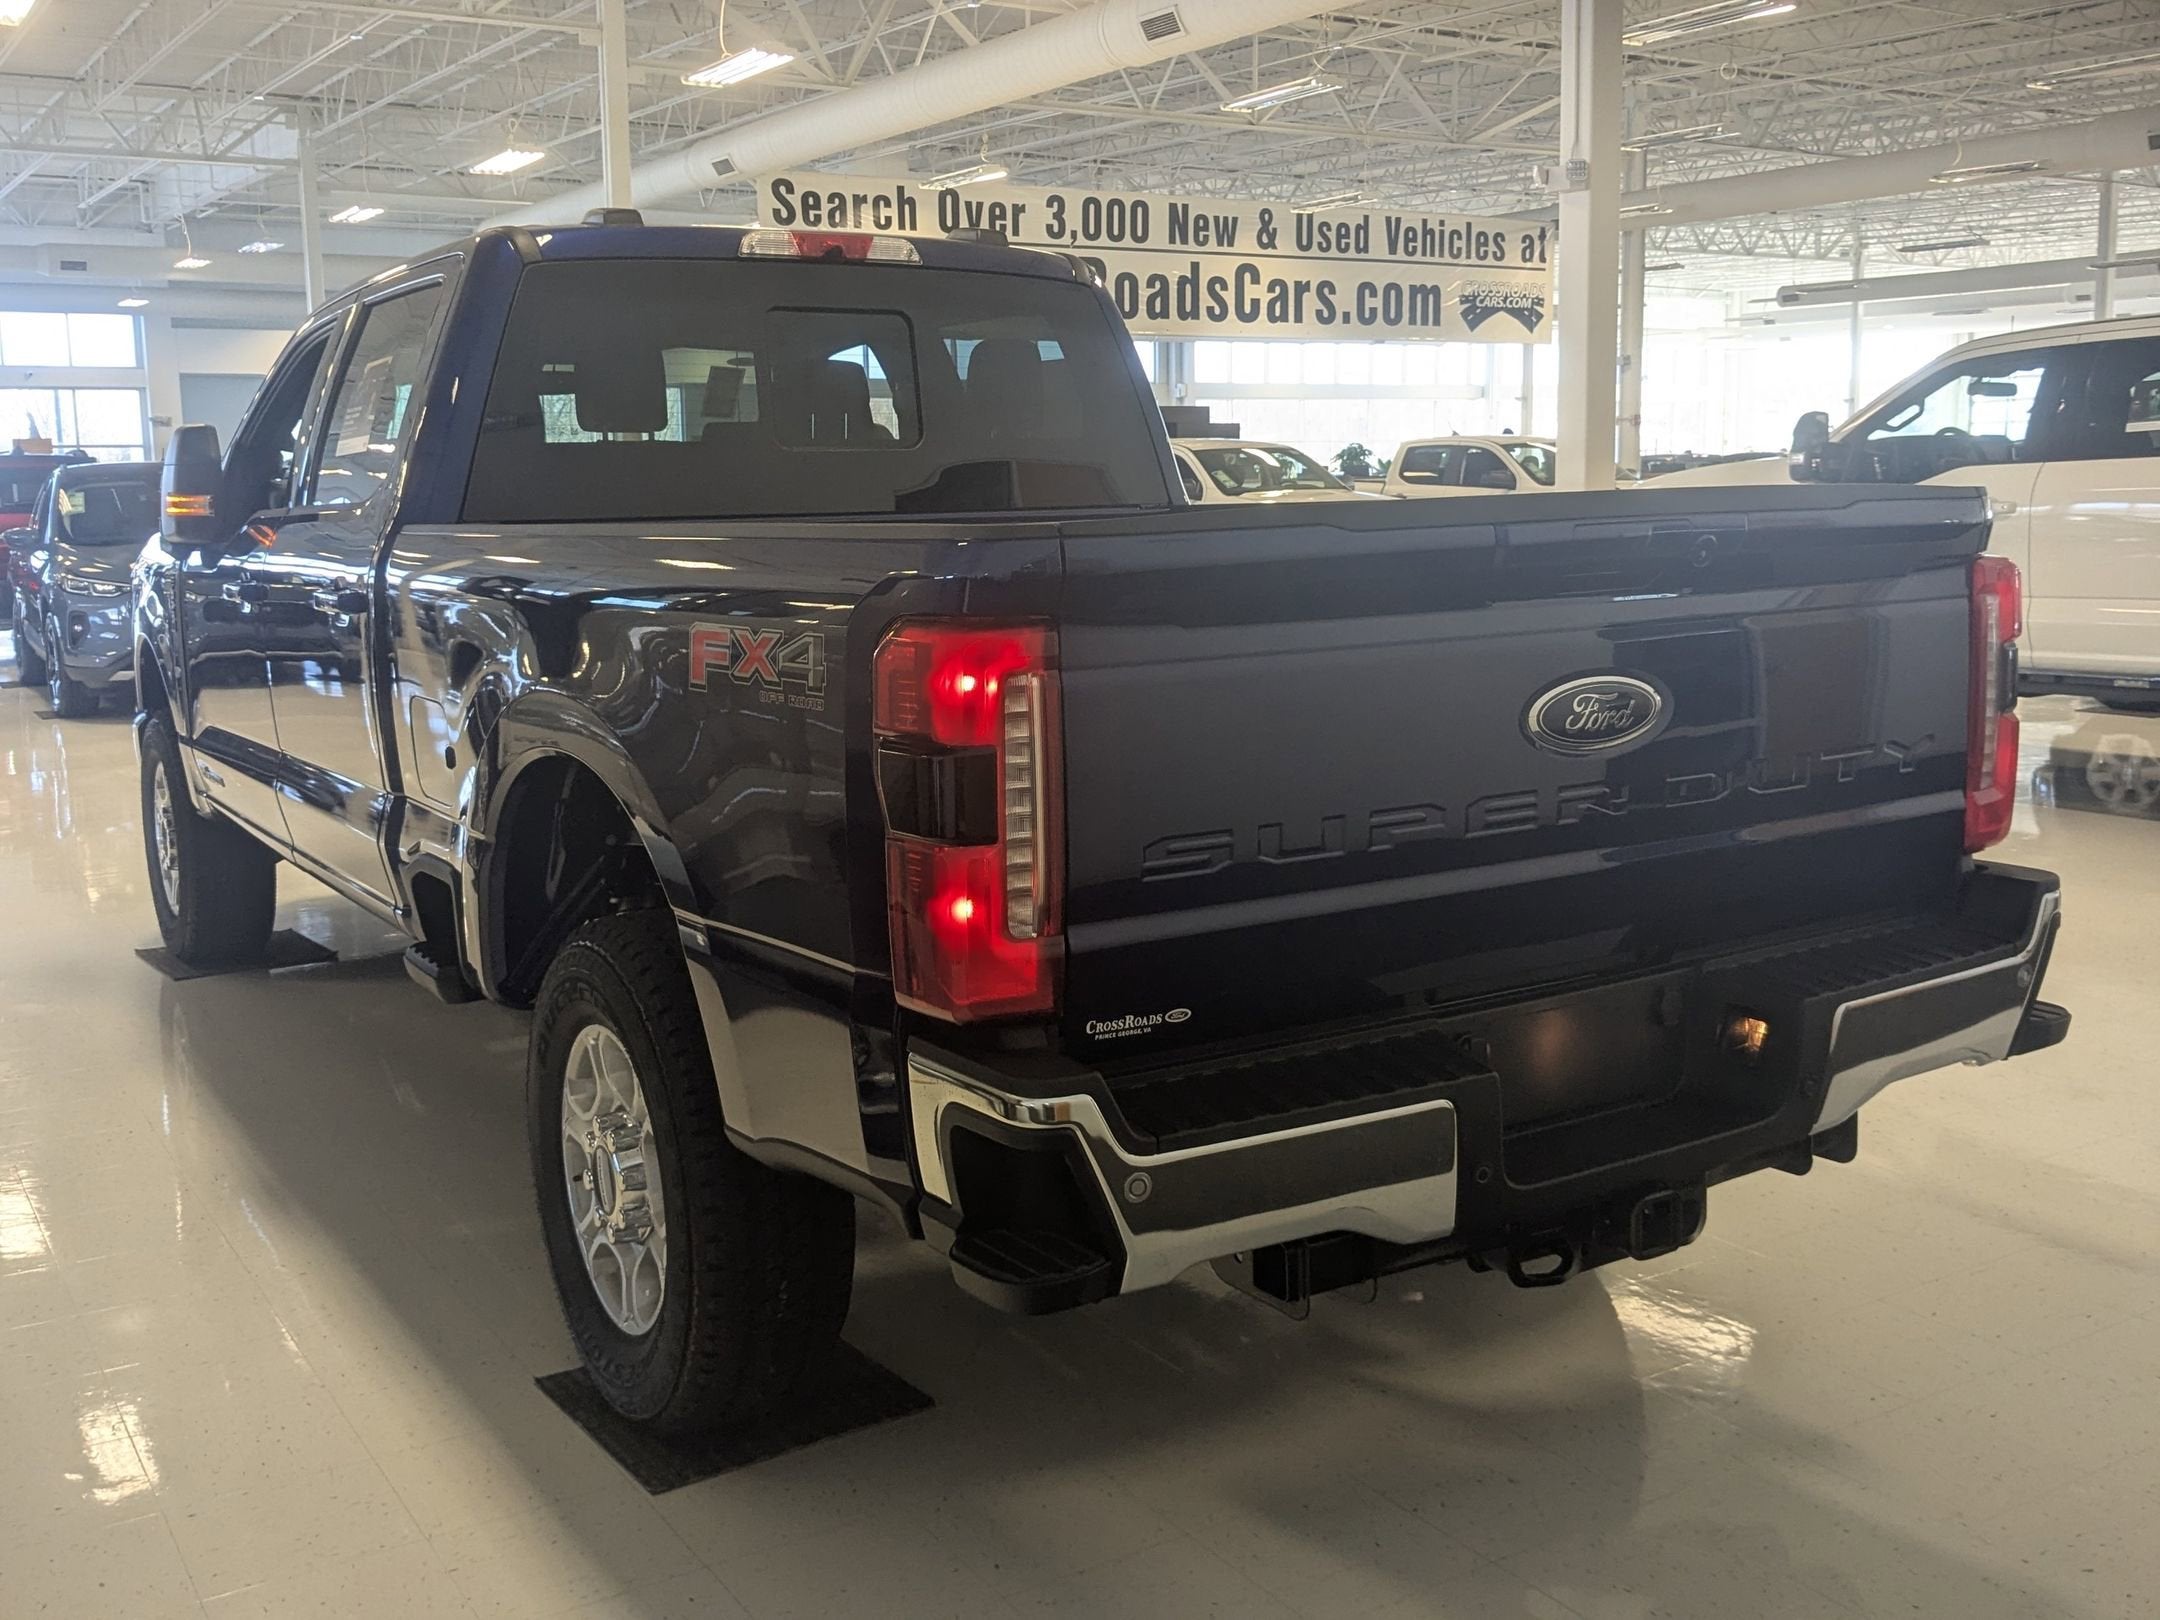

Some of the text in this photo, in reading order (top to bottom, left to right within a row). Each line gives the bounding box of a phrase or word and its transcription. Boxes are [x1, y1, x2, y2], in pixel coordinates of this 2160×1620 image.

[771, 177, 1547, 264] Search Over 3,000 New & Used Vehicles at
[1079, 256, 1442, 327] oadsCars.com
[1463, 280, 1546, 298] CROSSROADS
[1476, 296, 1532, 309] CARS.COM
[689, 621, 827, 696] FX4
[759, 690, 825, 712] OFF ROAD
[1565, 692, 1635, 731] Ford
[1141, 733, 1936, 883] SUPER DUTY
[1095, 1031, 1116, 1041] PRINCE
